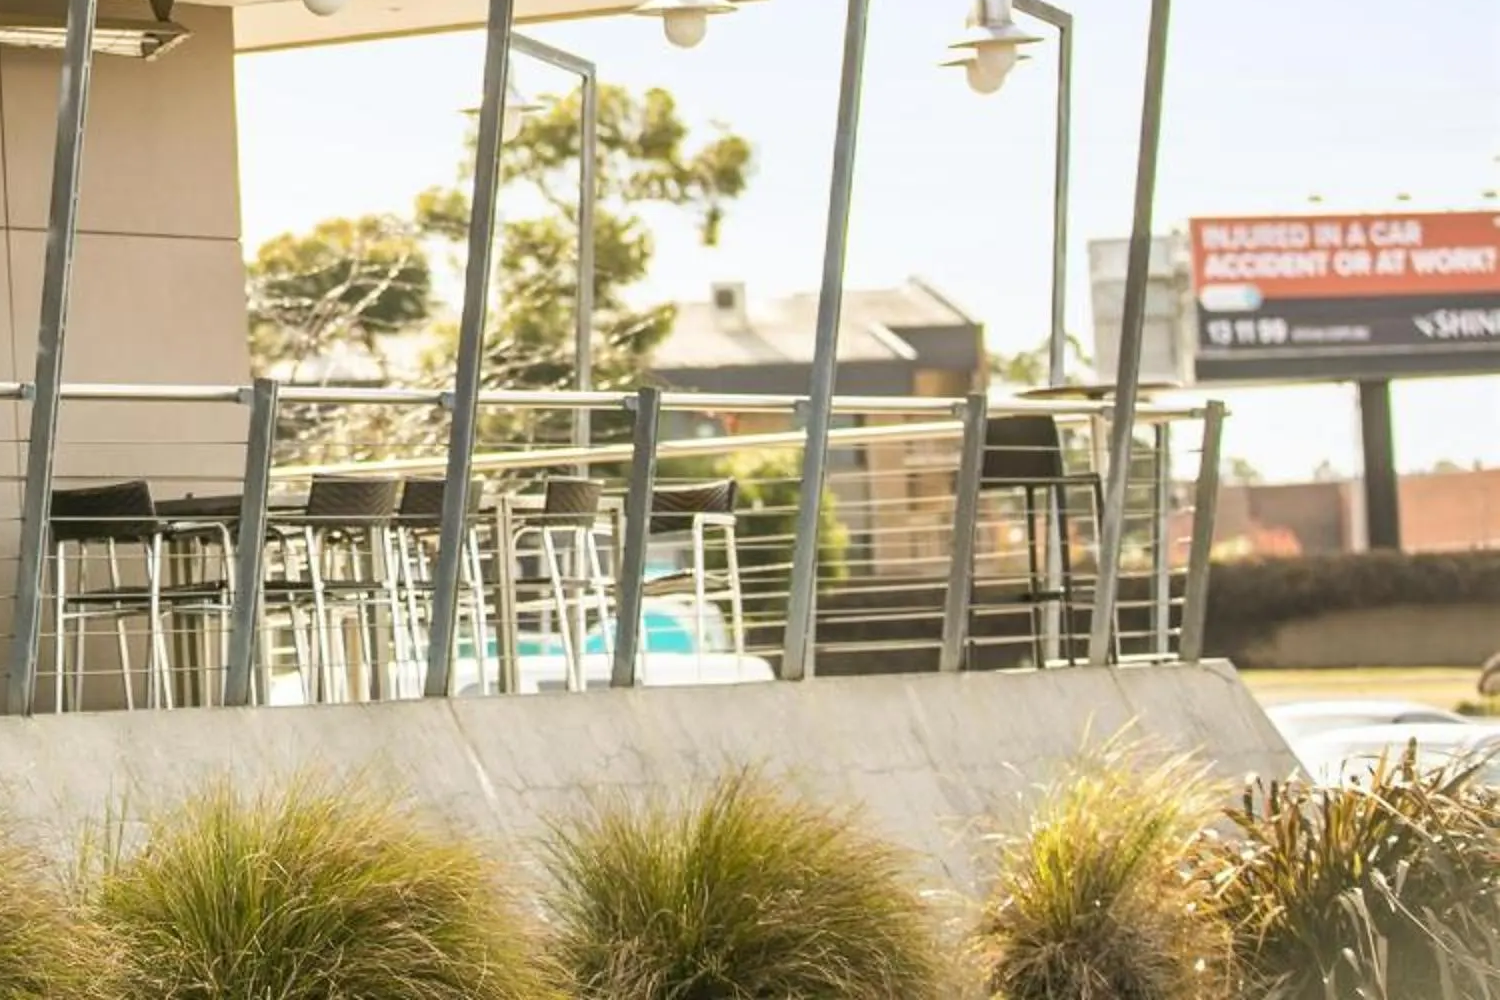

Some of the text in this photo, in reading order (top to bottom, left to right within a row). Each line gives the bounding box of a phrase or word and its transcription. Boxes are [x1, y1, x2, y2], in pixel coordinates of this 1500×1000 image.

[1315, 222, 1342, 247] IN
[1347, 221, 1367, 247] A
[1370, 218, 1422, 247] CAR
[1204, 245, 1497, 280] ACCIDENT OR AT WORK?
[1433, 307, 1500, 338] SHIN
